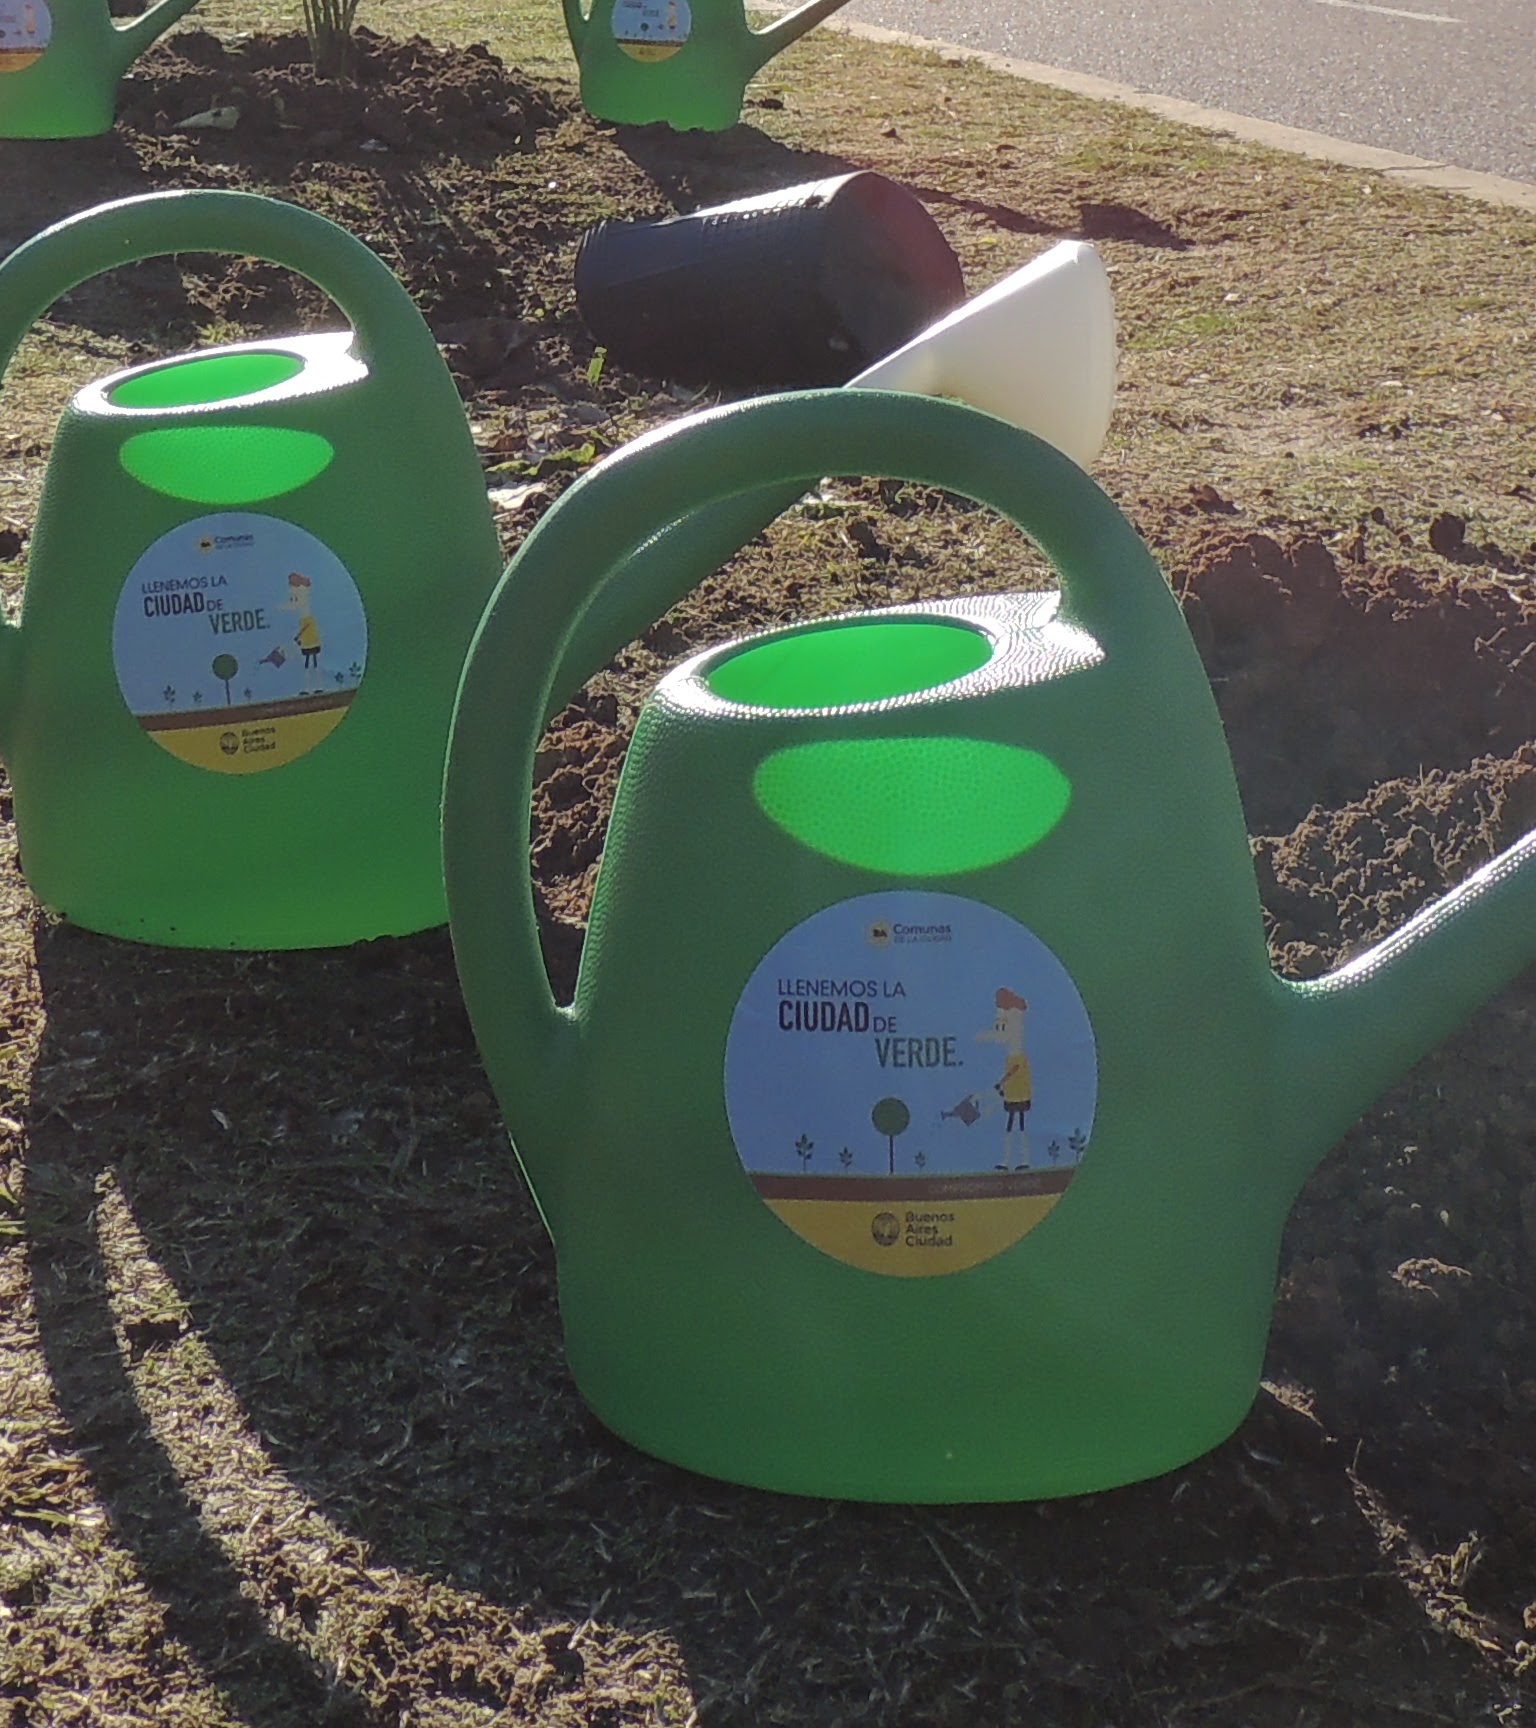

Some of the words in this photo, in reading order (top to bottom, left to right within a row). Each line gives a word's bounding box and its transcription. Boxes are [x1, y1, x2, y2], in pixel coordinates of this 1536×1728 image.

[142, 576, 208, 594] LLENEMOS
[211, 574, 228, 588] LA
[143, 592, 205, 618] CIUDAD
[207, 599, 223, 612] DE
[209, 608, 270, 635] VERDE.
[893, 923, 952, 936] Comunas
[778, 978, 878, 998] LLENEMOS
[883, 981, 906, 998] LA
[779, 1000, 870, 1033] CIUDAD
[873, 1016, 897, 1033] DE
[874, 1036, 964, 1069] VERDE.
[905, 1211, 955, 1223] Buenos
[905, 1223, 939, 1235] Aires
[905, 1234, 953, 1247] Ciudad
